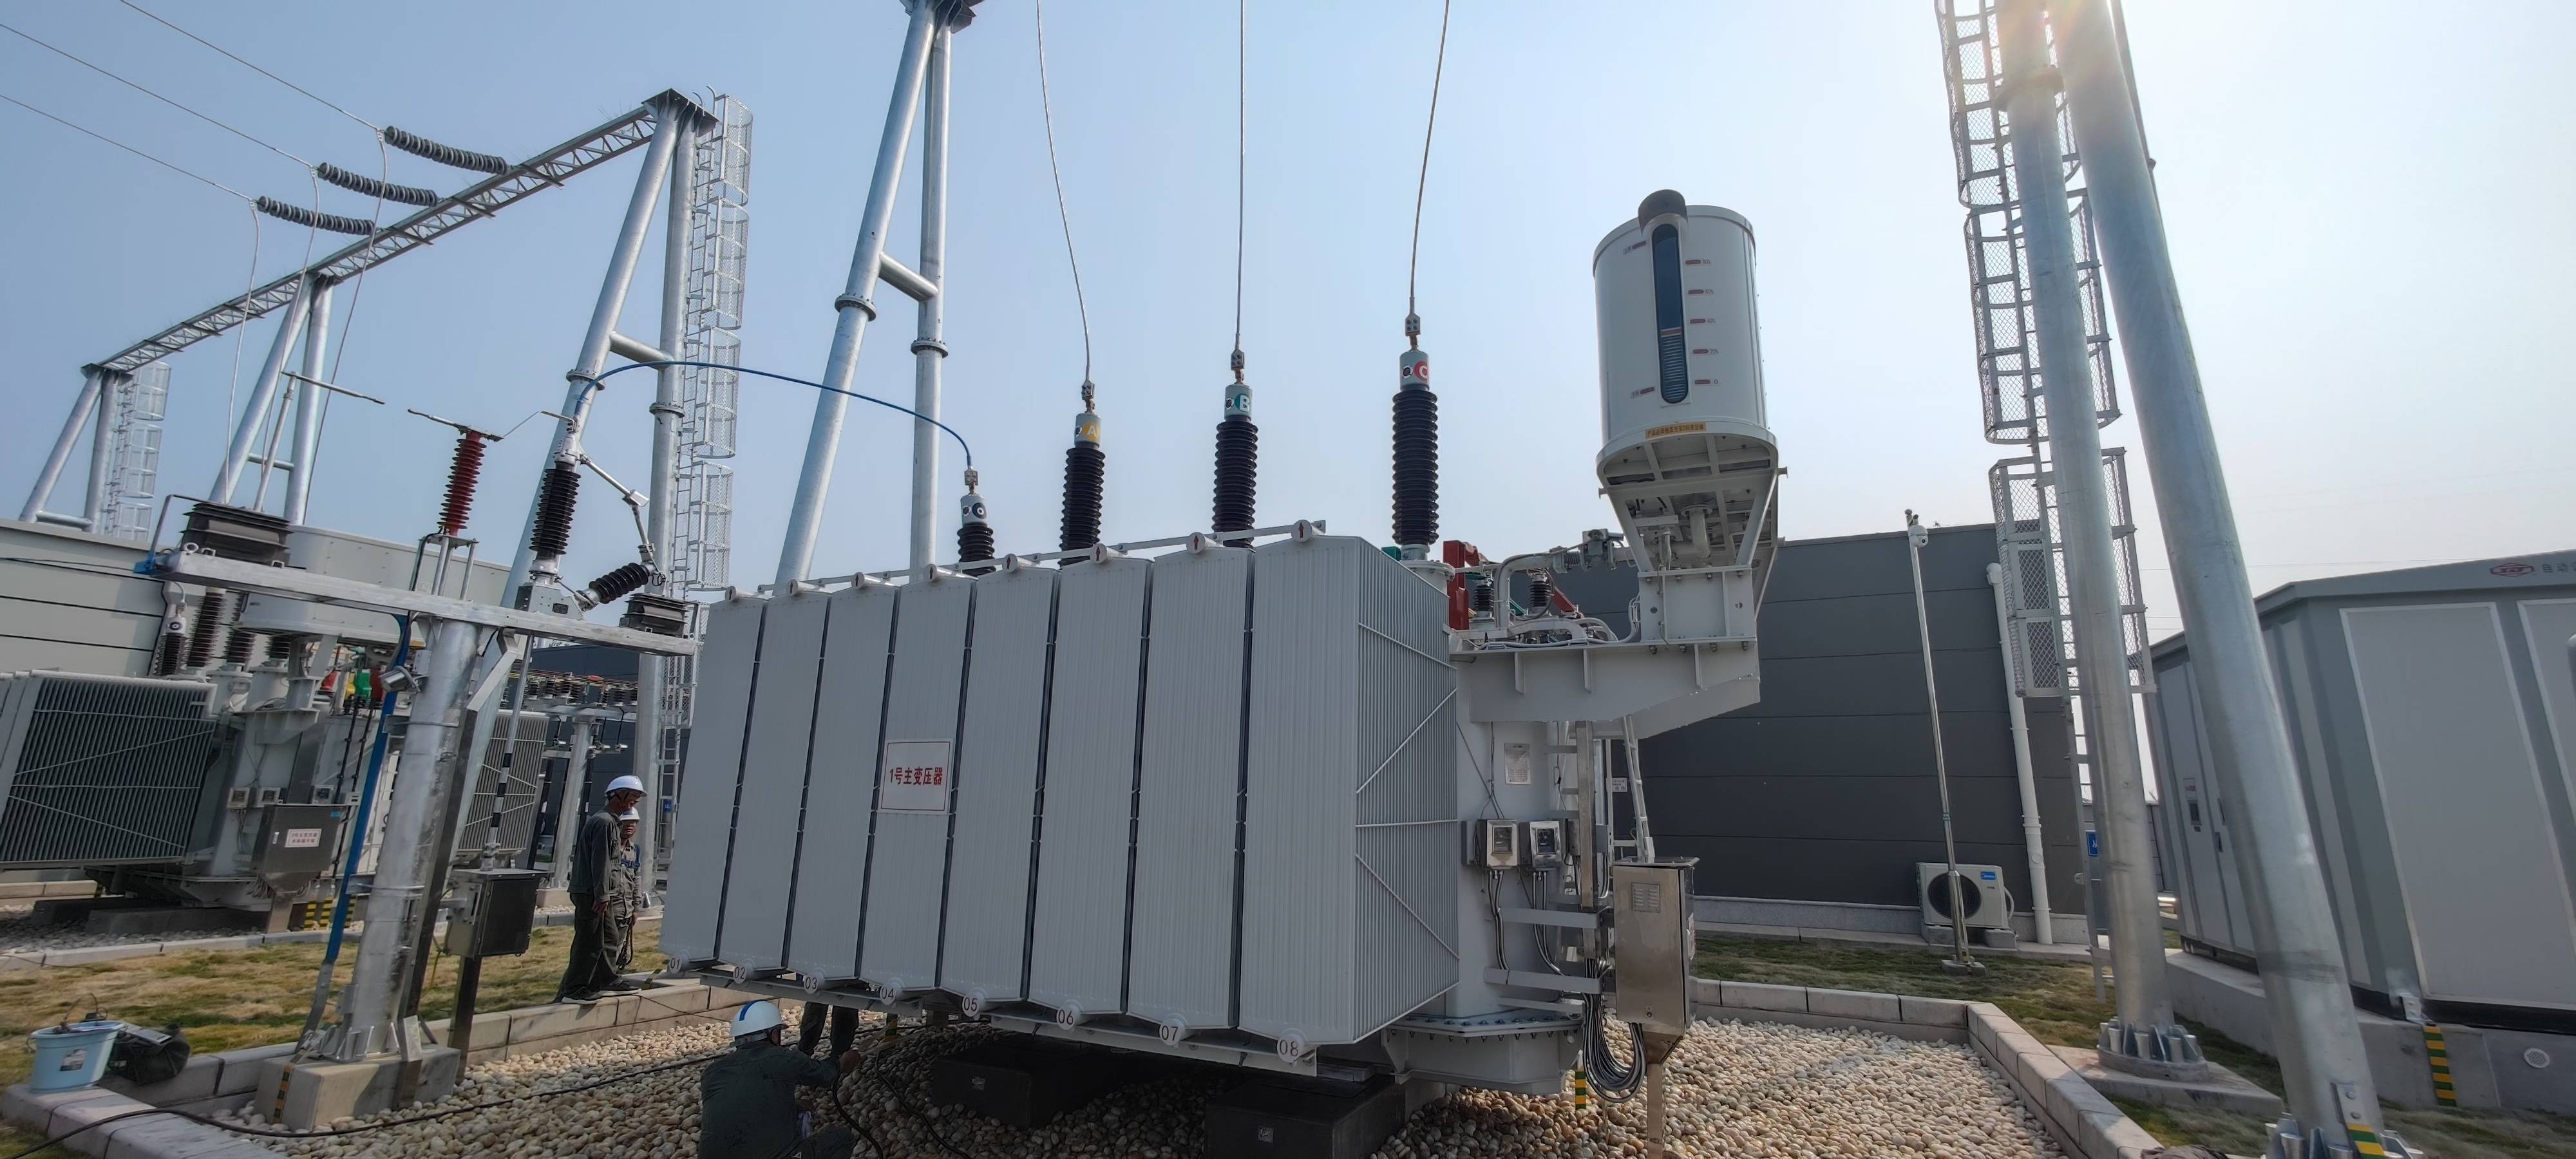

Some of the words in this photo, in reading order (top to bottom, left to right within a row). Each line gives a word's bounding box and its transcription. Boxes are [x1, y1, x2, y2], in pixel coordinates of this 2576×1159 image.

[1418, 365, 1428, 380] C
[1240, 395, 1250, 412] B
[1086, 424, 1097, 437] A
[890, 766, 943, 786] 1号主变压器
[670, 957, 681, 970] 01
[734, 966, 746, 979] 02
[805, 977, 817, 990] 03
[881, 987, 894, 999] 04
[964, 998, 978, 1012] 05
[1058, 1009, 1074, 1024] 06
[1161, 1025, 1179, 1041] 07
[1279, 1039, 1298, 1057] 08
